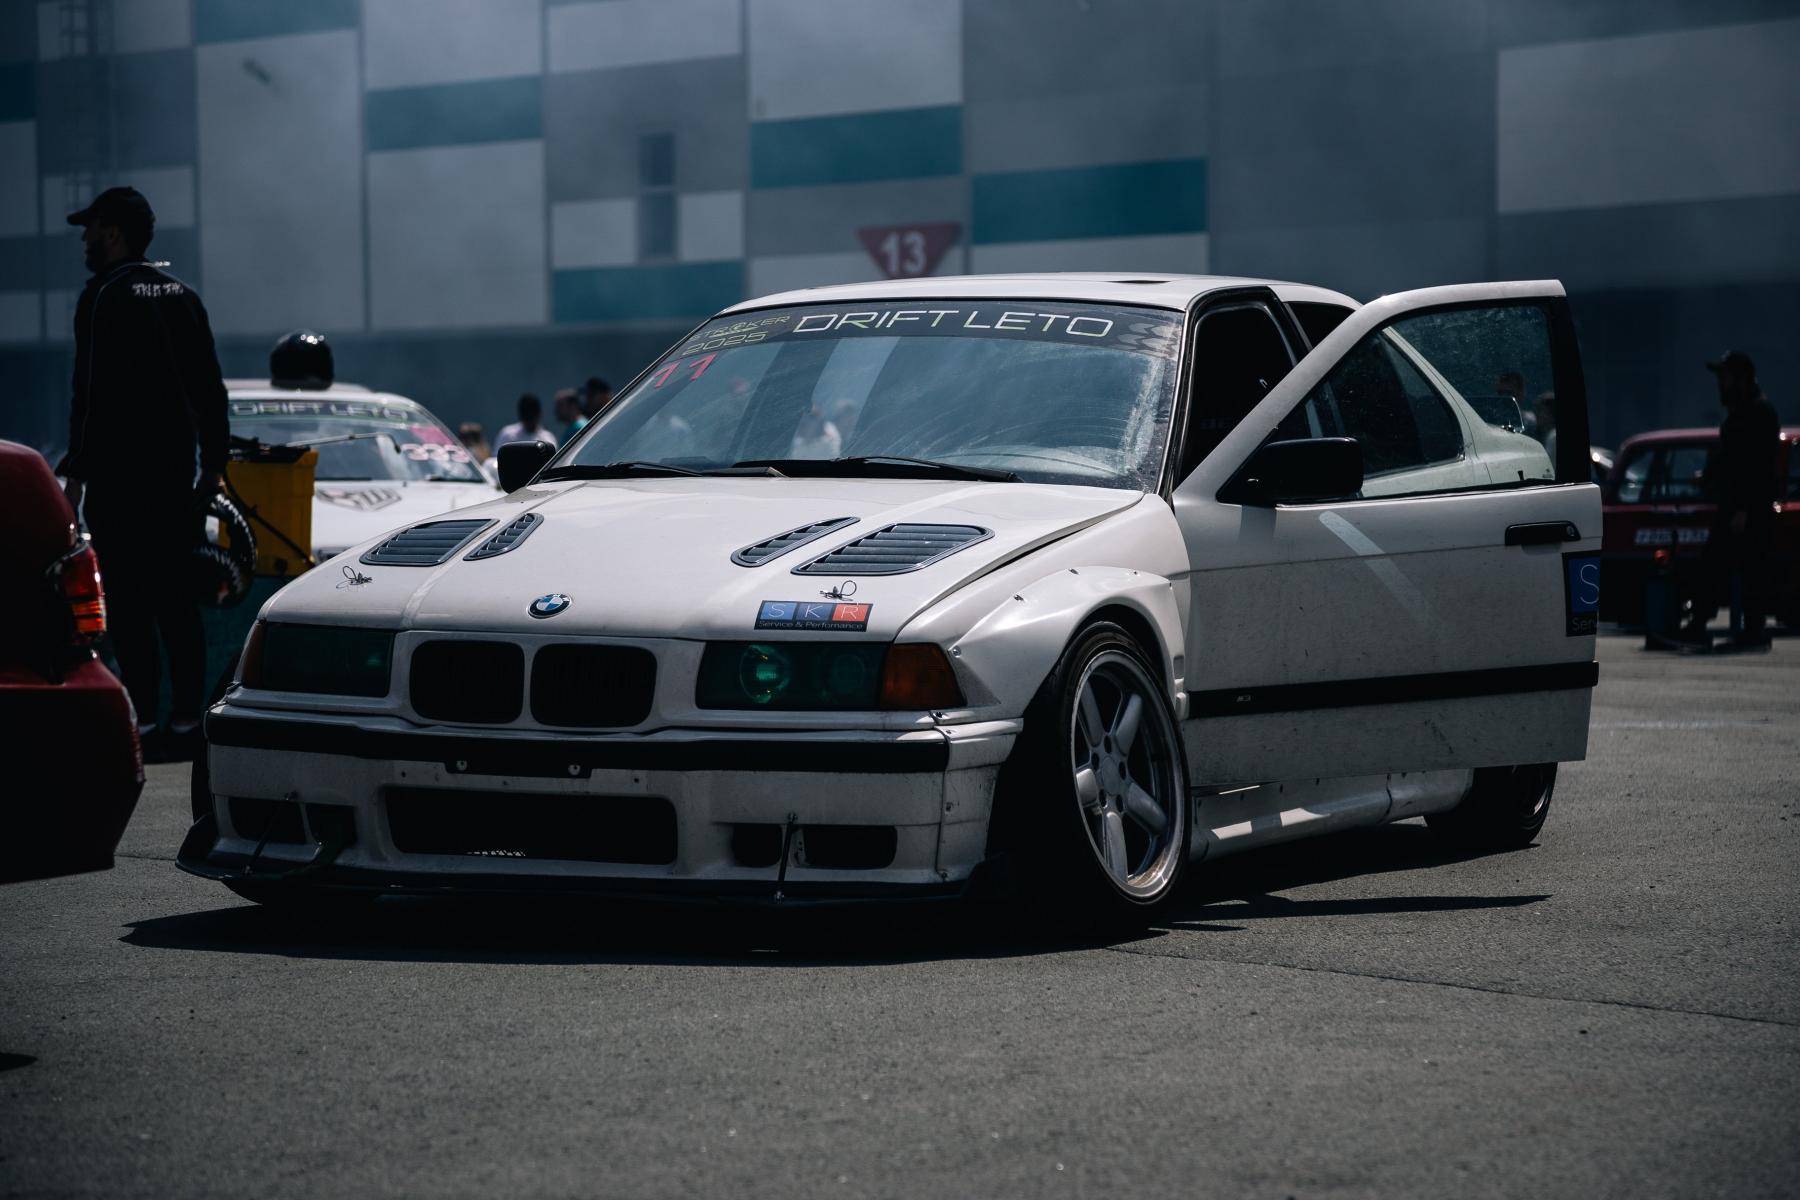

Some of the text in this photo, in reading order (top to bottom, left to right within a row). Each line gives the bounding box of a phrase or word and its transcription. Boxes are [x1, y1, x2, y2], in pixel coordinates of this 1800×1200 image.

[879, 230, 928, 275] 13
[792, 310, 1113, 338] DRIFT LETO
[682, 331, 768, 356] 2025
[654, 352, 718, 389] 11
[233, 402, 408, 420] DRIFT LETO
[768, 603, 858, 619] SKR
[759, 620, 794, 628] Service
